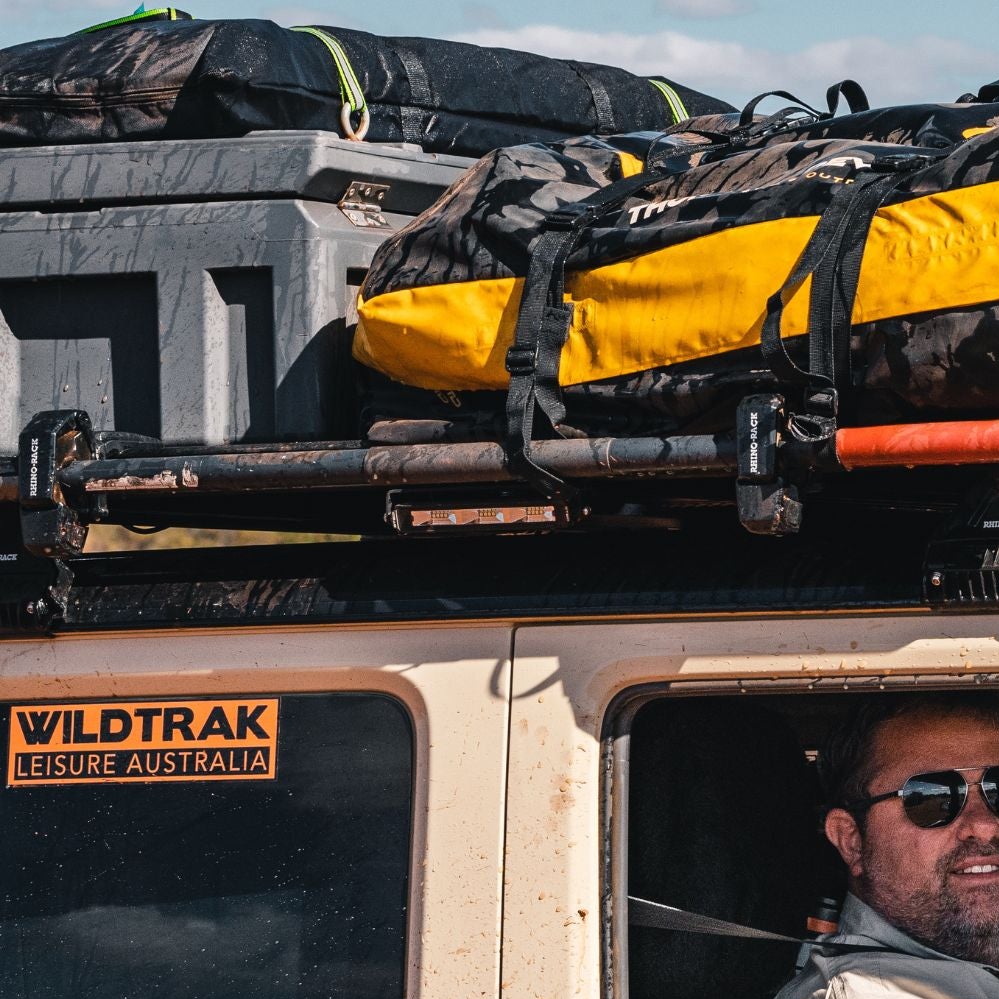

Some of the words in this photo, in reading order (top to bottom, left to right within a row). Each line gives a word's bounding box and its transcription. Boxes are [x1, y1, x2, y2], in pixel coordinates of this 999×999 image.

[30, 438, 38, 496] RHINO-RACK
[750, 412, 758, 474] RHINO-RACK
[16, 704, 271, 746] WILDTRAK
[17, 753, 117, 778] LEISURE
[126, 750, 268, 774] AUSTRALIA
